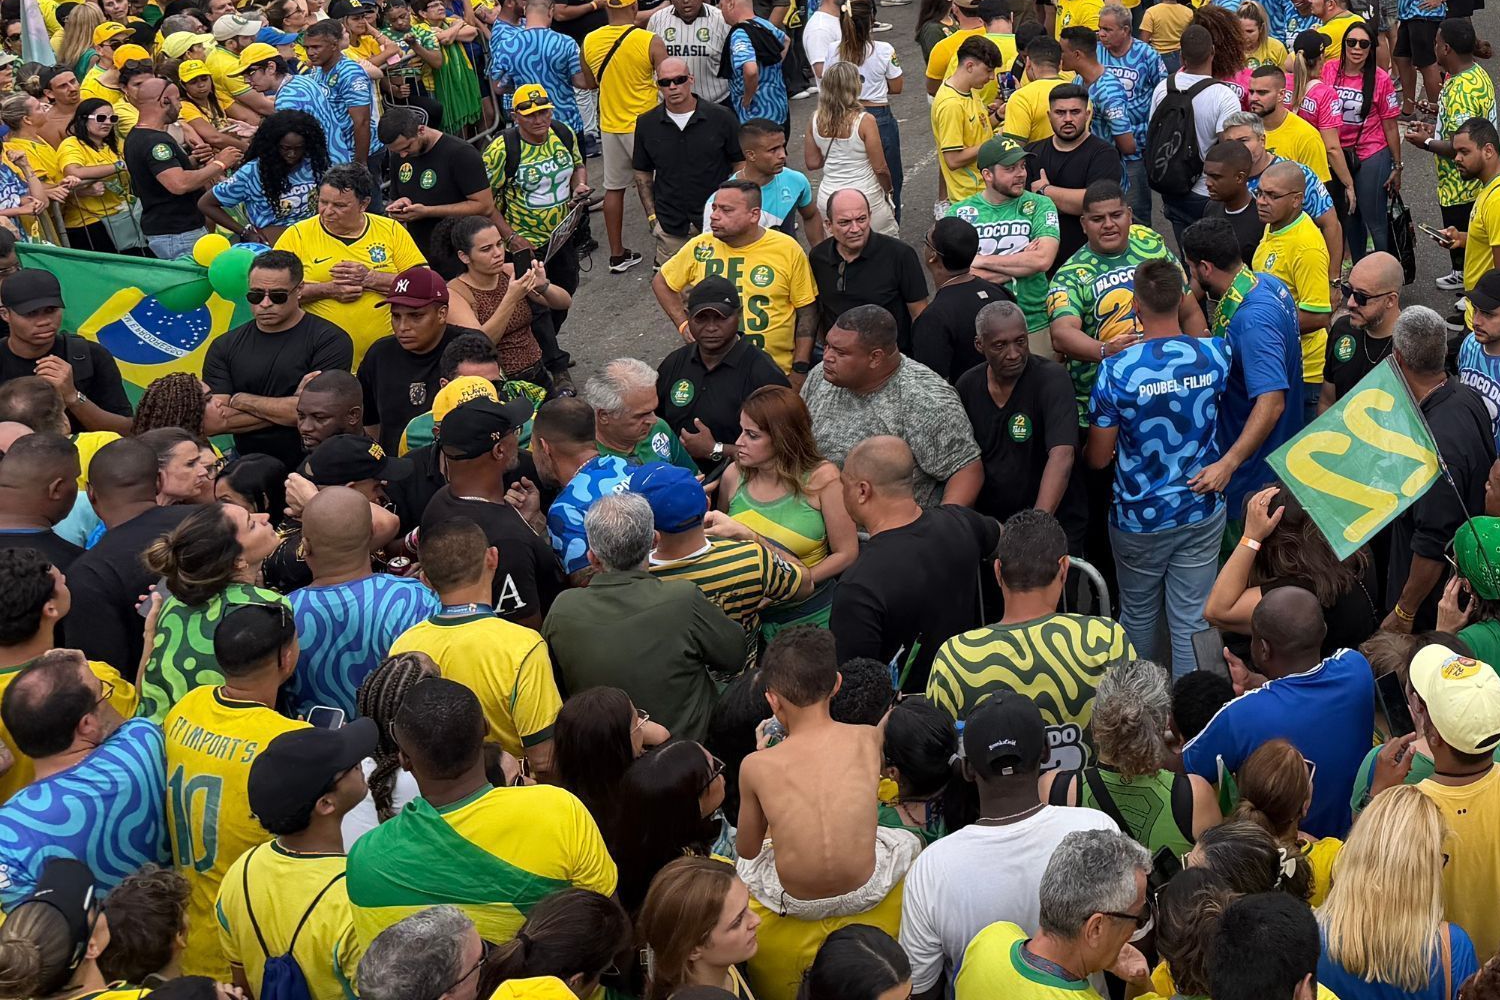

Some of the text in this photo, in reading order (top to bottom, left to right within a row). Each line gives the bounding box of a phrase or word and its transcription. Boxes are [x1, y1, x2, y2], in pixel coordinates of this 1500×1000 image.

[667, 45, 710, 57] BRASIL
[977, 223, 1030, 238] LOCO DO
[394, 278, 410, 293] NY
[1096, 269, 1137, 294] BLOCO
[1138, 373, 1213, 398] POUBEL FILHO
[1459, 370, 1490, 394] BLOCO
[1014, 415, 1025, 426] 22
[1047, 728, 1077, 746] DO
[168, 764, 222, 873] 10
